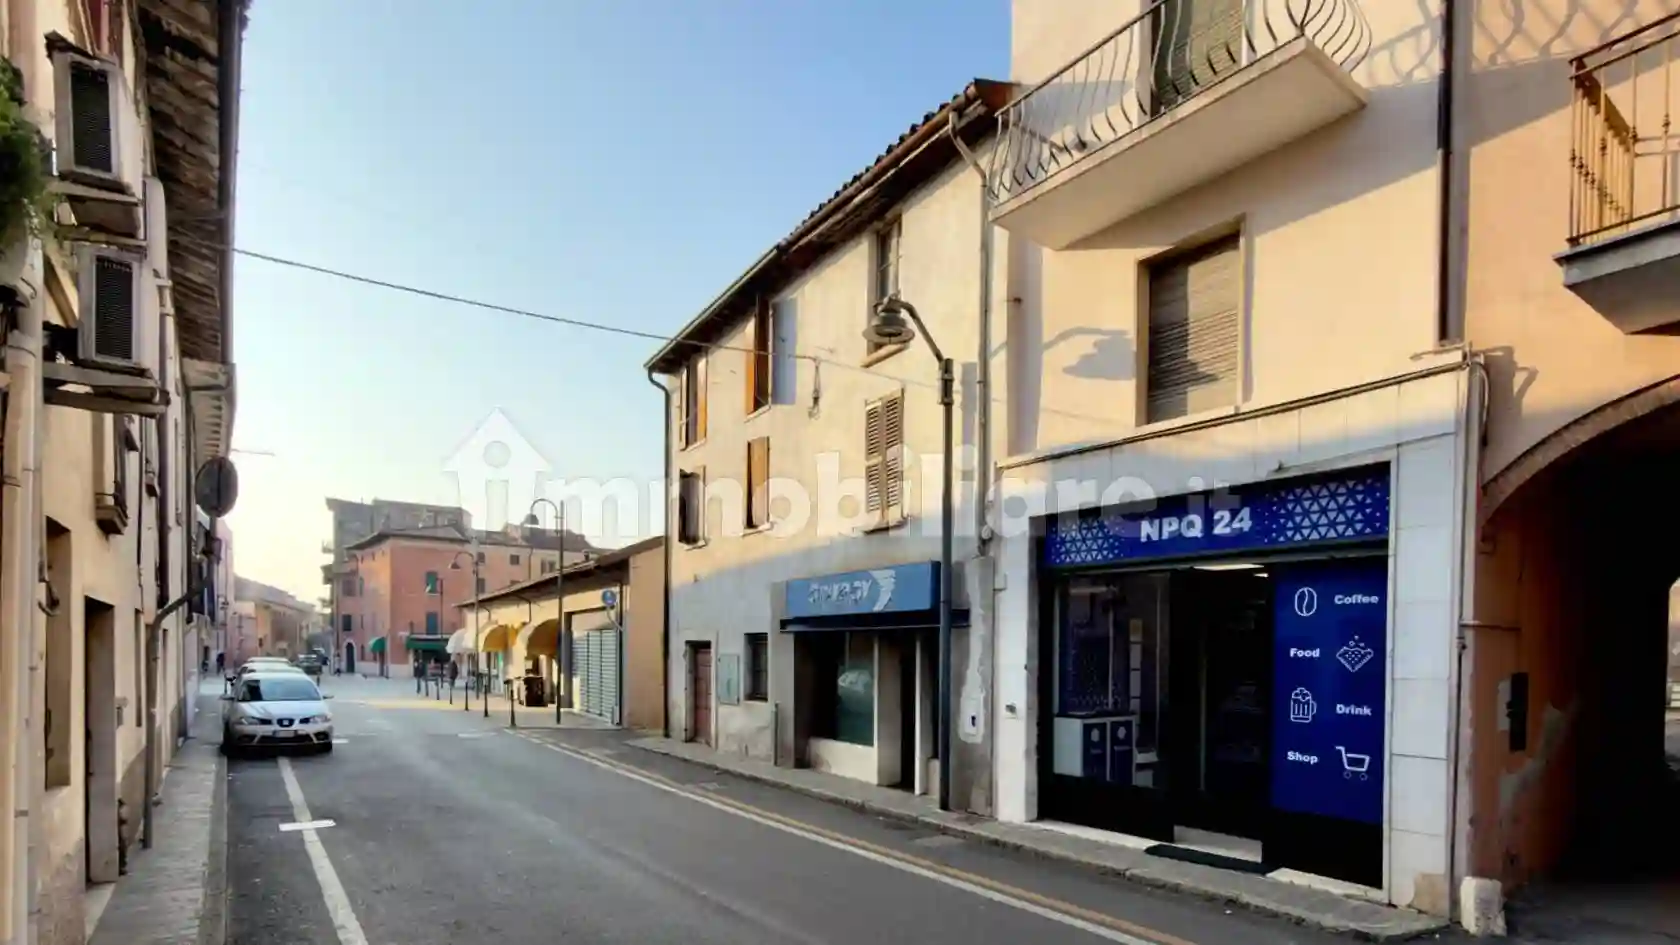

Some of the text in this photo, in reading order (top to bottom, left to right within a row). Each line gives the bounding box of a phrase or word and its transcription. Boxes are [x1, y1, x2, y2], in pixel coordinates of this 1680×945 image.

[1139, 507, 1252, 543] NPQ 24
[1334, 594, 1379, 605] Coffee
[1290, 647, 1320, 658] Food
[1336, 703, 1372, 716] Drink
[1287, 750, 1319, 765] Shop
